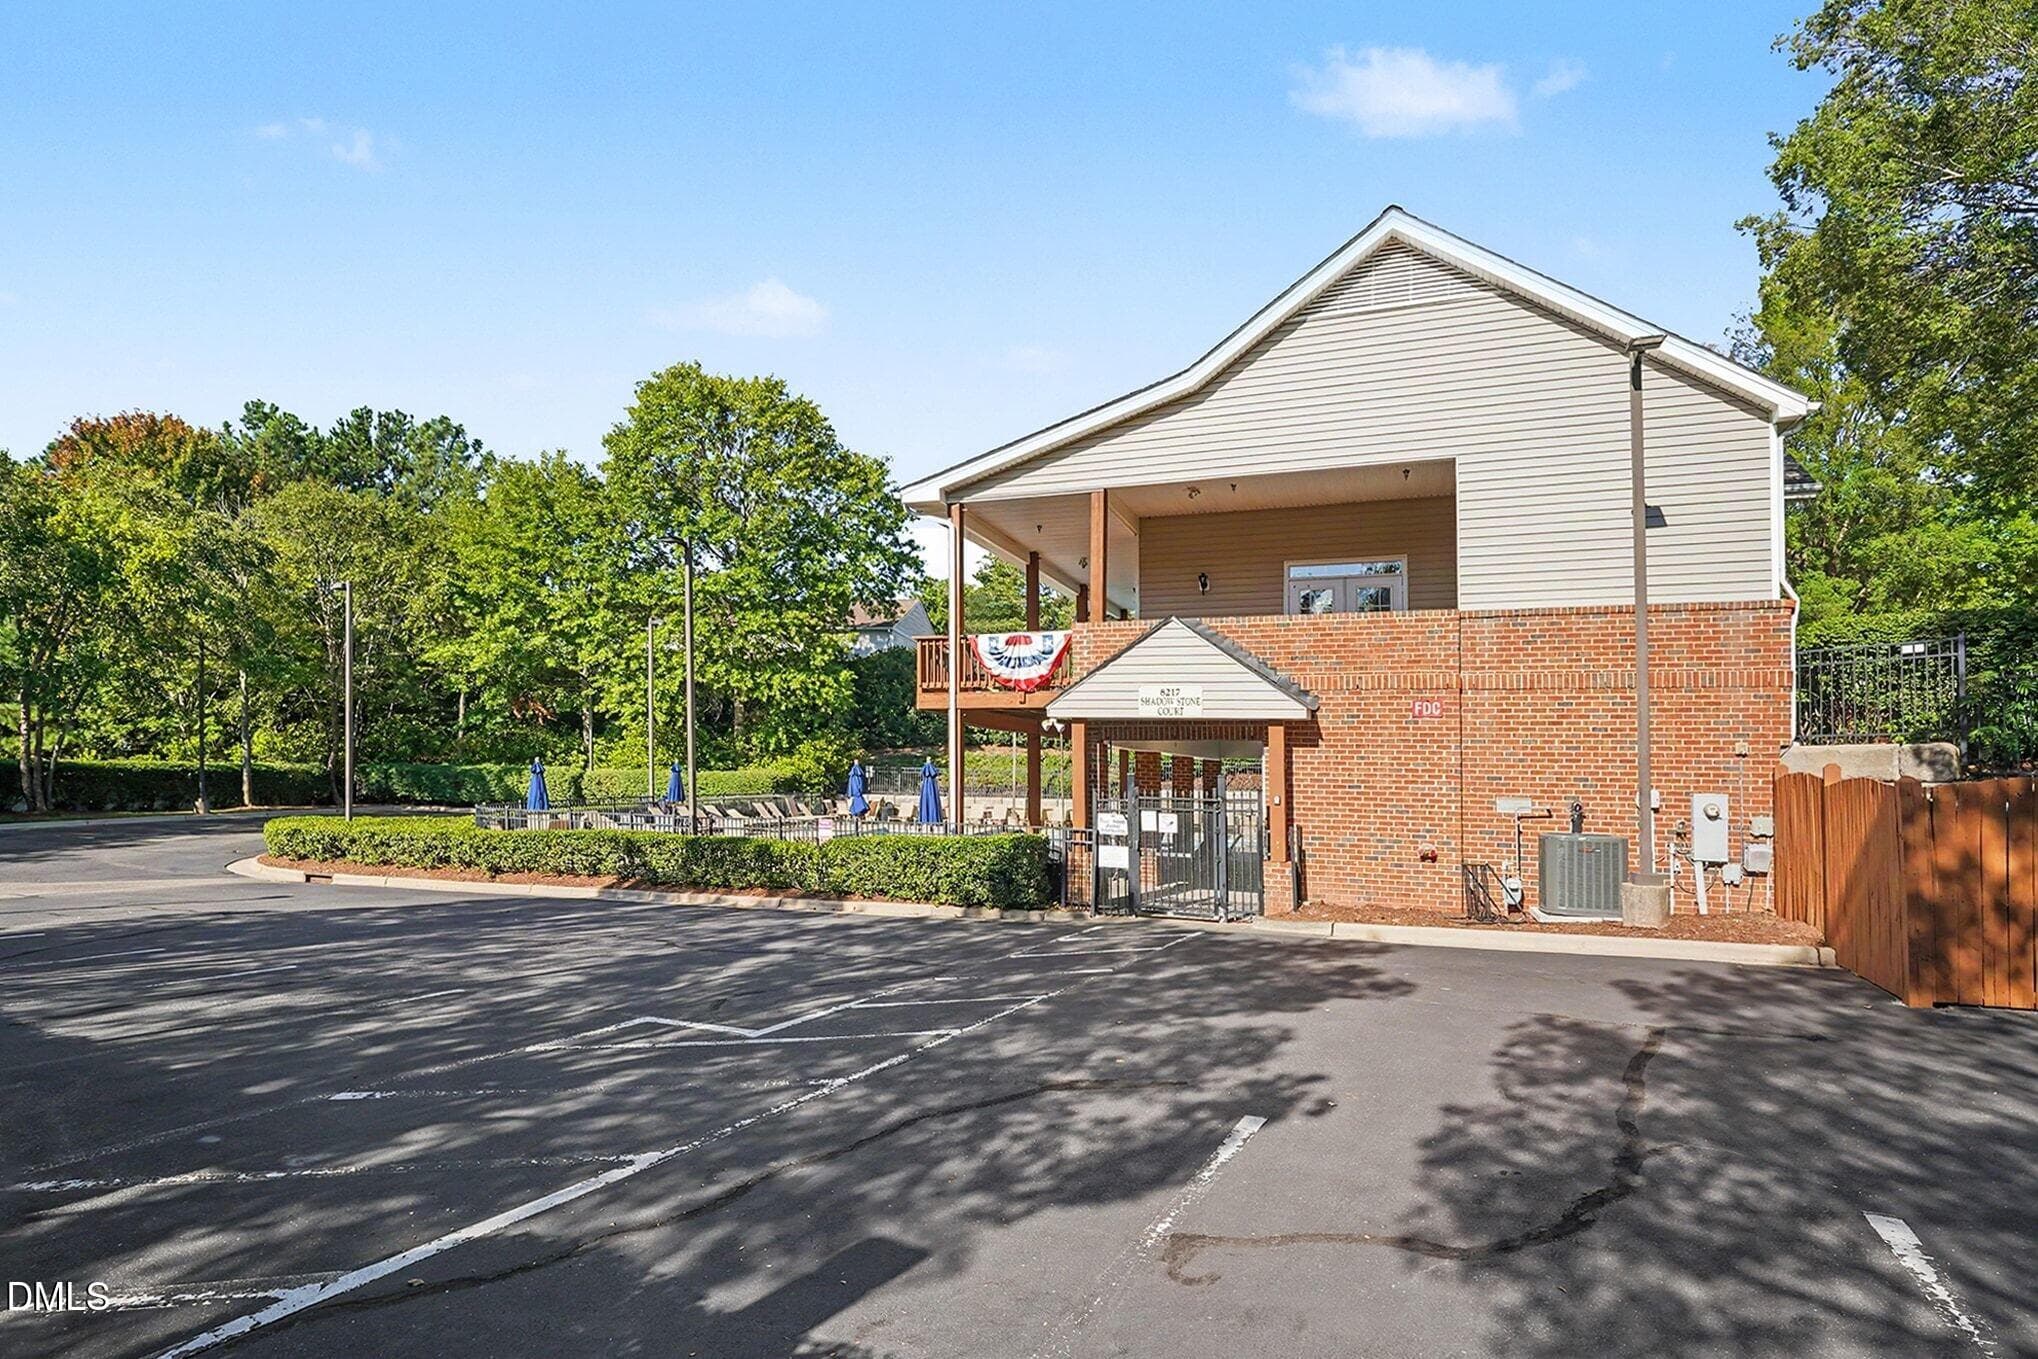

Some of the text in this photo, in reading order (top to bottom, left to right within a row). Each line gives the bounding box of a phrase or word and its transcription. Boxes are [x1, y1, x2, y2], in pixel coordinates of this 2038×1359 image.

[1140, 697, 1201, 706] SHADOW STONE
[1157, 707, 1184, 716] COURT
[1414, 701, 1441, 716] FDC
